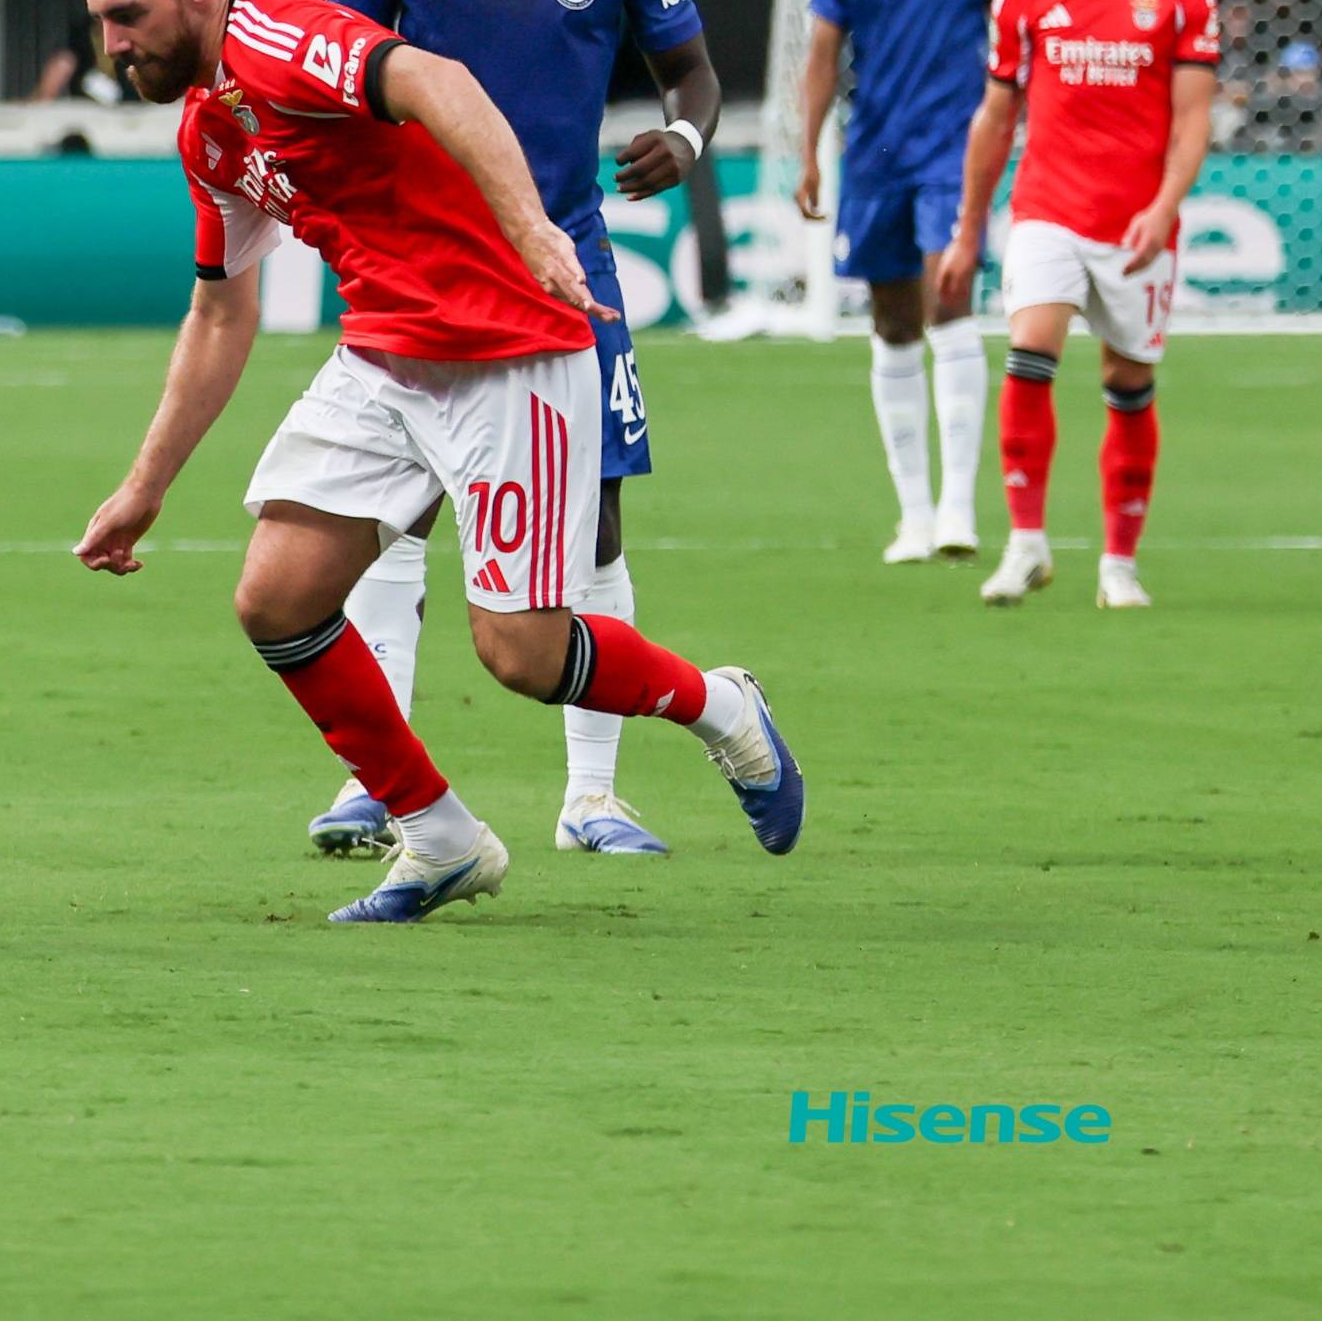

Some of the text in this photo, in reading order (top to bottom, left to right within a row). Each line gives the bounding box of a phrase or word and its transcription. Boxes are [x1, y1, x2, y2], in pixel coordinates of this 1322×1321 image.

[1045, 34, 1154, 67] Emirates
[610, 347, 646, 424] 45
[468, 481, 526, 554] 10
